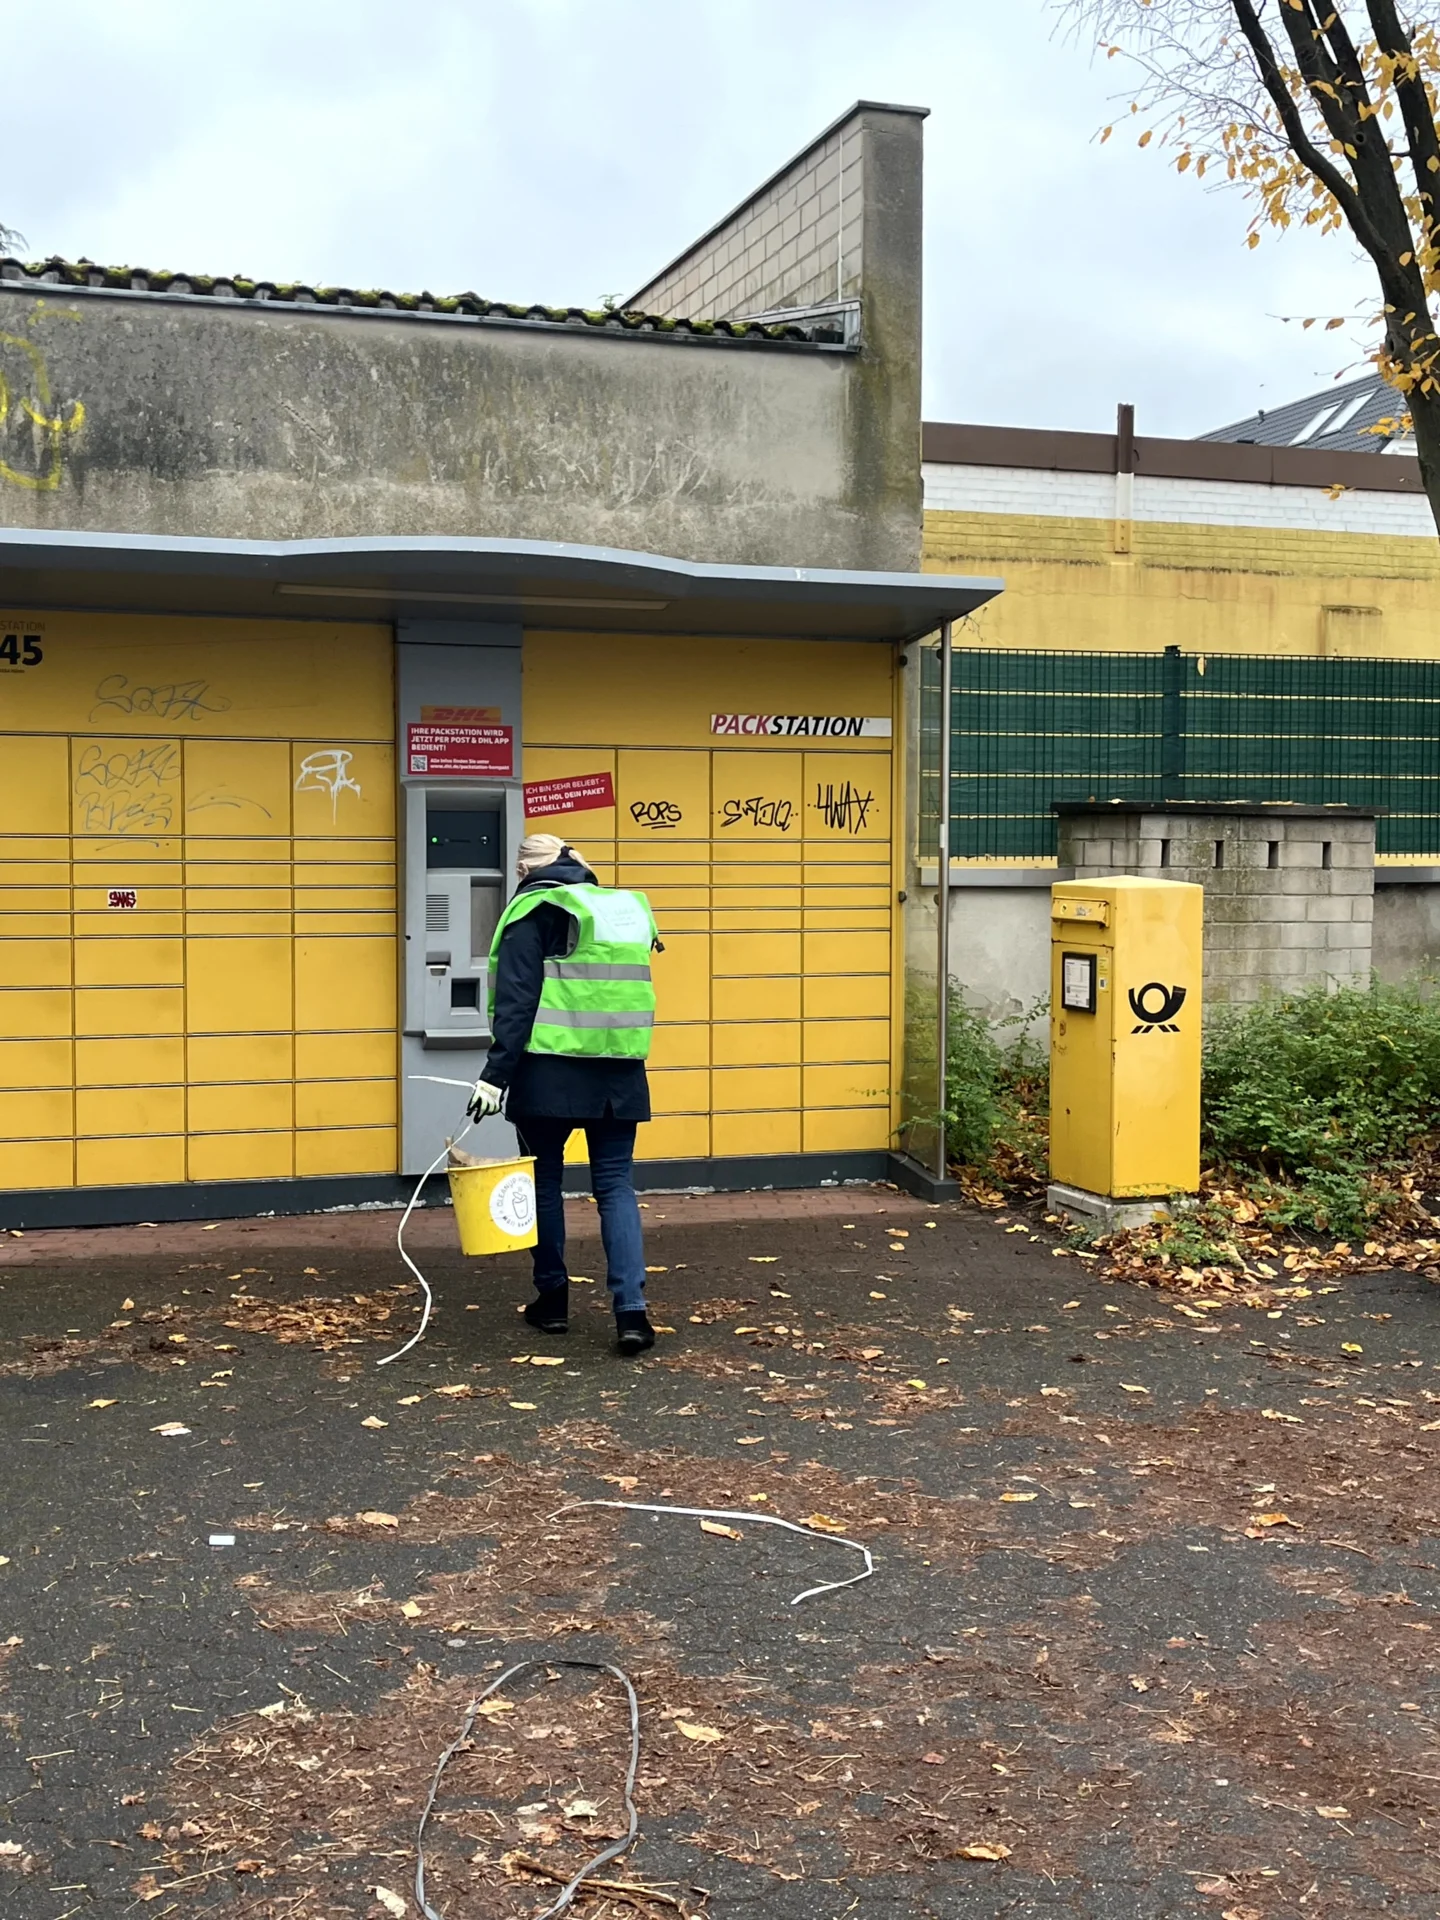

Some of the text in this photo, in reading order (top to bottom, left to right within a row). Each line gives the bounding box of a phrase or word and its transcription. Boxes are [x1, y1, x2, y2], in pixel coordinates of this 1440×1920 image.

[0, 634, 43, 666] 45
[432, 708, 489, 721] DHL
[411, 727, 504, 737] IHRE PACKSTATION WIRD
[712, 714, 864, 736] PACKSTATION
[411, 735, 433, 743] JETZT
[451, 736, 470, 744] POST
[539, 785, 551, 793] BIN
[552, 782, 571, 791] SEHR
[572, 778, 600, 788] BELIEBT
[527, 787, 605, 804] BITTE HOL DEIN PAKET
[528, 801, 574, 813] SCHNELL AB!
